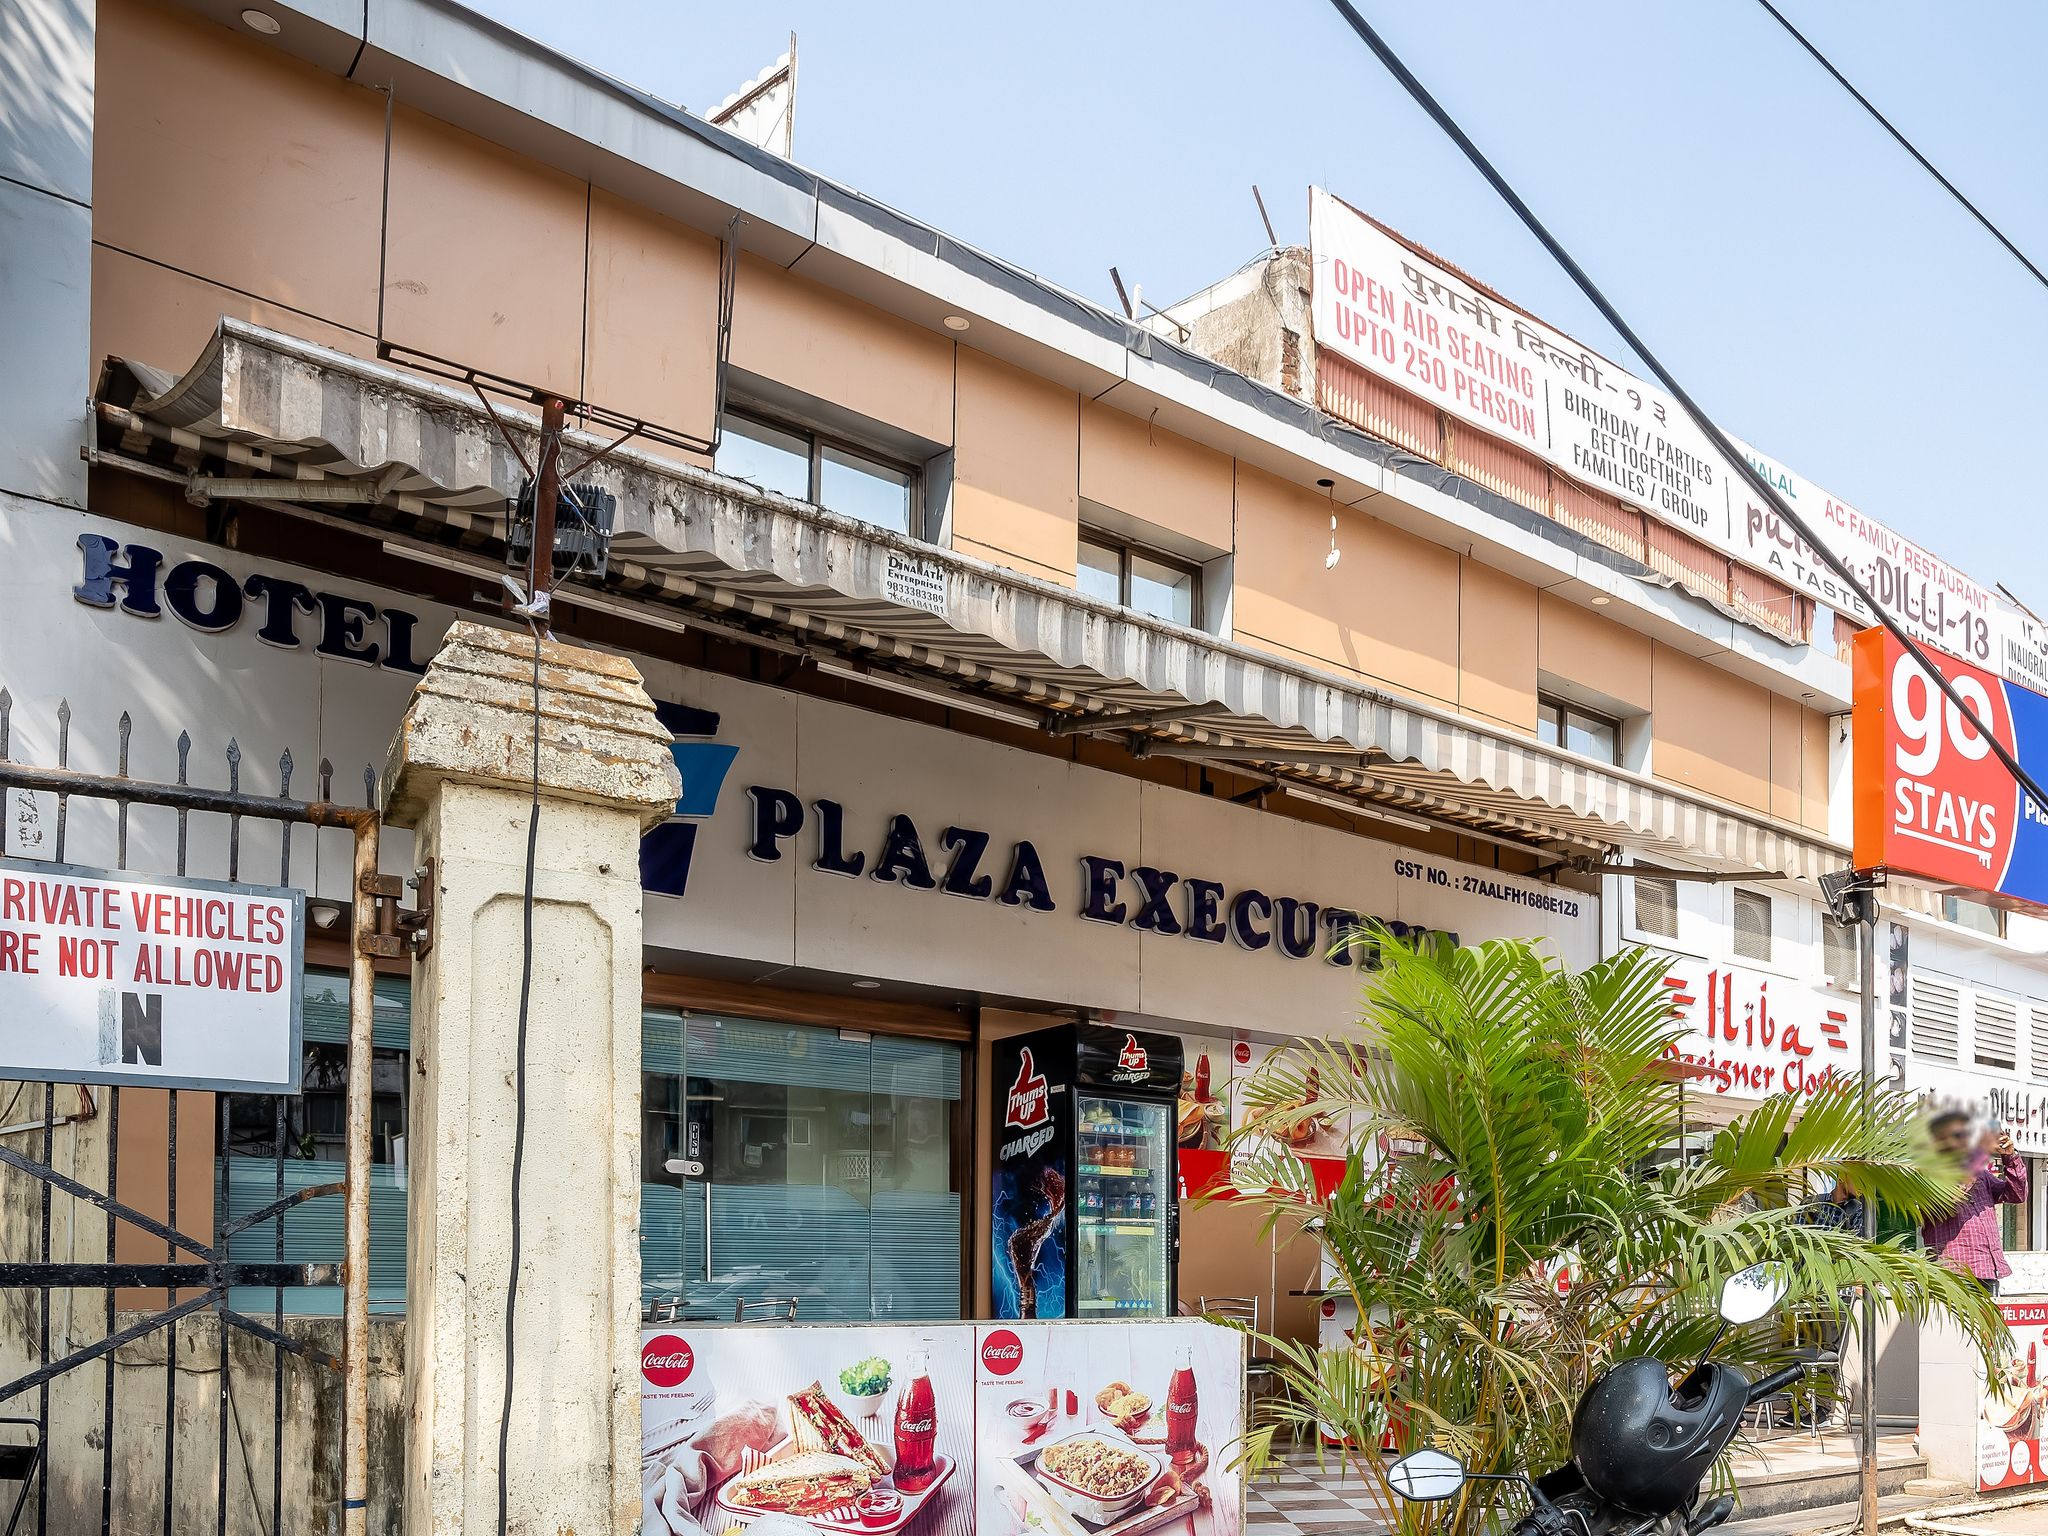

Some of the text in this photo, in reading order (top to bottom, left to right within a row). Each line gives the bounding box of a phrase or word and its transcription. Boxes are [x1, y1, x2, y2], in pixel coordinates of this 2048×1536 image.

[1335, 259, 1534, 399] OPEN AIR SEATING
[1336, 301, 1536, 440] UPTO 250 PERSON
[1564, 388, 1639, 446] BIRTHDAY
[1657, 437, 1712, 485] PARTIES
[1591, 427, 1692, 498] GET TOGETHER
[1574, 443, 1645, 497] FAMILIES
[1662, 488, 1708, 528] GROUP
[1768, 550, 1865, 615] A TASTE
[1825, 499, 1989, 613] AC FAMILY RESTAURANT
[74, 532, 434, 676] HOTEL
[887, 581, 944, 604] 9833383389
[1891, 652, 1995, 777] go
[1895, 777, 1998, 849] STAYS
[746, 785, 1461, 974] PLAZA EXECUTI
[1394, 859, 1423, 881] GST
[1427, 866, 1452, 889] NO.
[1462, 875, 1580, 918] 27AALFH1686E1Z8
[131, 891, 285, 945] VEHICLES
[58, 936, 119, 980] NOT
[133, 943, 283, 993] ALLOWED
[1010, 1084, 1045, 1113] Thums
[1112, 1071, 1150, 1083] CHARGED
[1000, 1125, 1055, 1162] CHARGED
[2019, 1308, 2046, 1320] PLAZA
